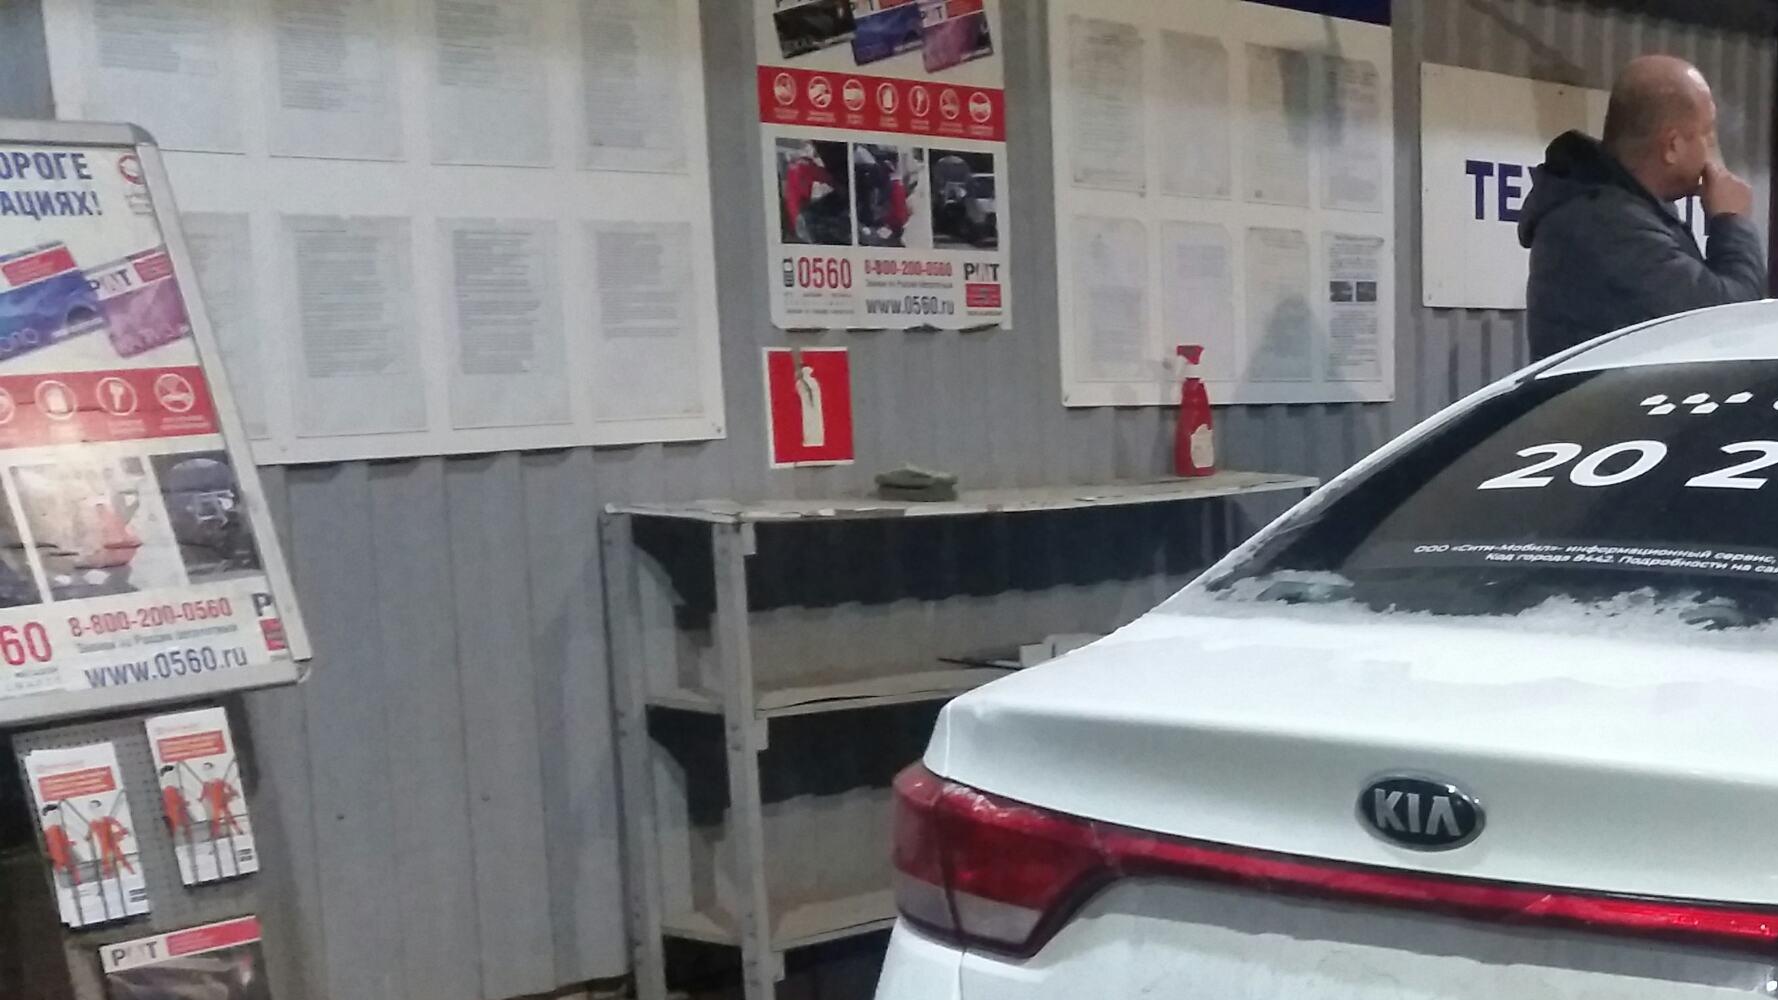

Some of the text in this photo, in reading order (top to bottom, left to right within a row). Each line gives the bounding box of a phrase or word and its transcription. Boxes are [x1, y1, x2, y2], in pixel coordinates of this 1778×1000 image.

[0, 191, 103, 221] АЦИЯХ!
[797, 256, 852, 289] 0560
[866, 295, 955, 315] www.0560.ru
[1478, 440, 1668, 490] 20
[1413, 544, 1450, 553] ООО
[1565, 544, 1712, 560] информационный
[1714, 552, 1776, 564] сервис,
[1485, 553, 1515, 562] Код
[1516, 553, 1570, 562] города
[1573, 554, 1614, 563] 8442.
[1618, 555, 1728, 570] Подробности
[1730, 563, 1752, 572] на
[67, 597, 233, 637] 8-800-200-0560
[84, 646, 248, 689] www.0560.ru
[1374, 788, 1461, 836] KIA
